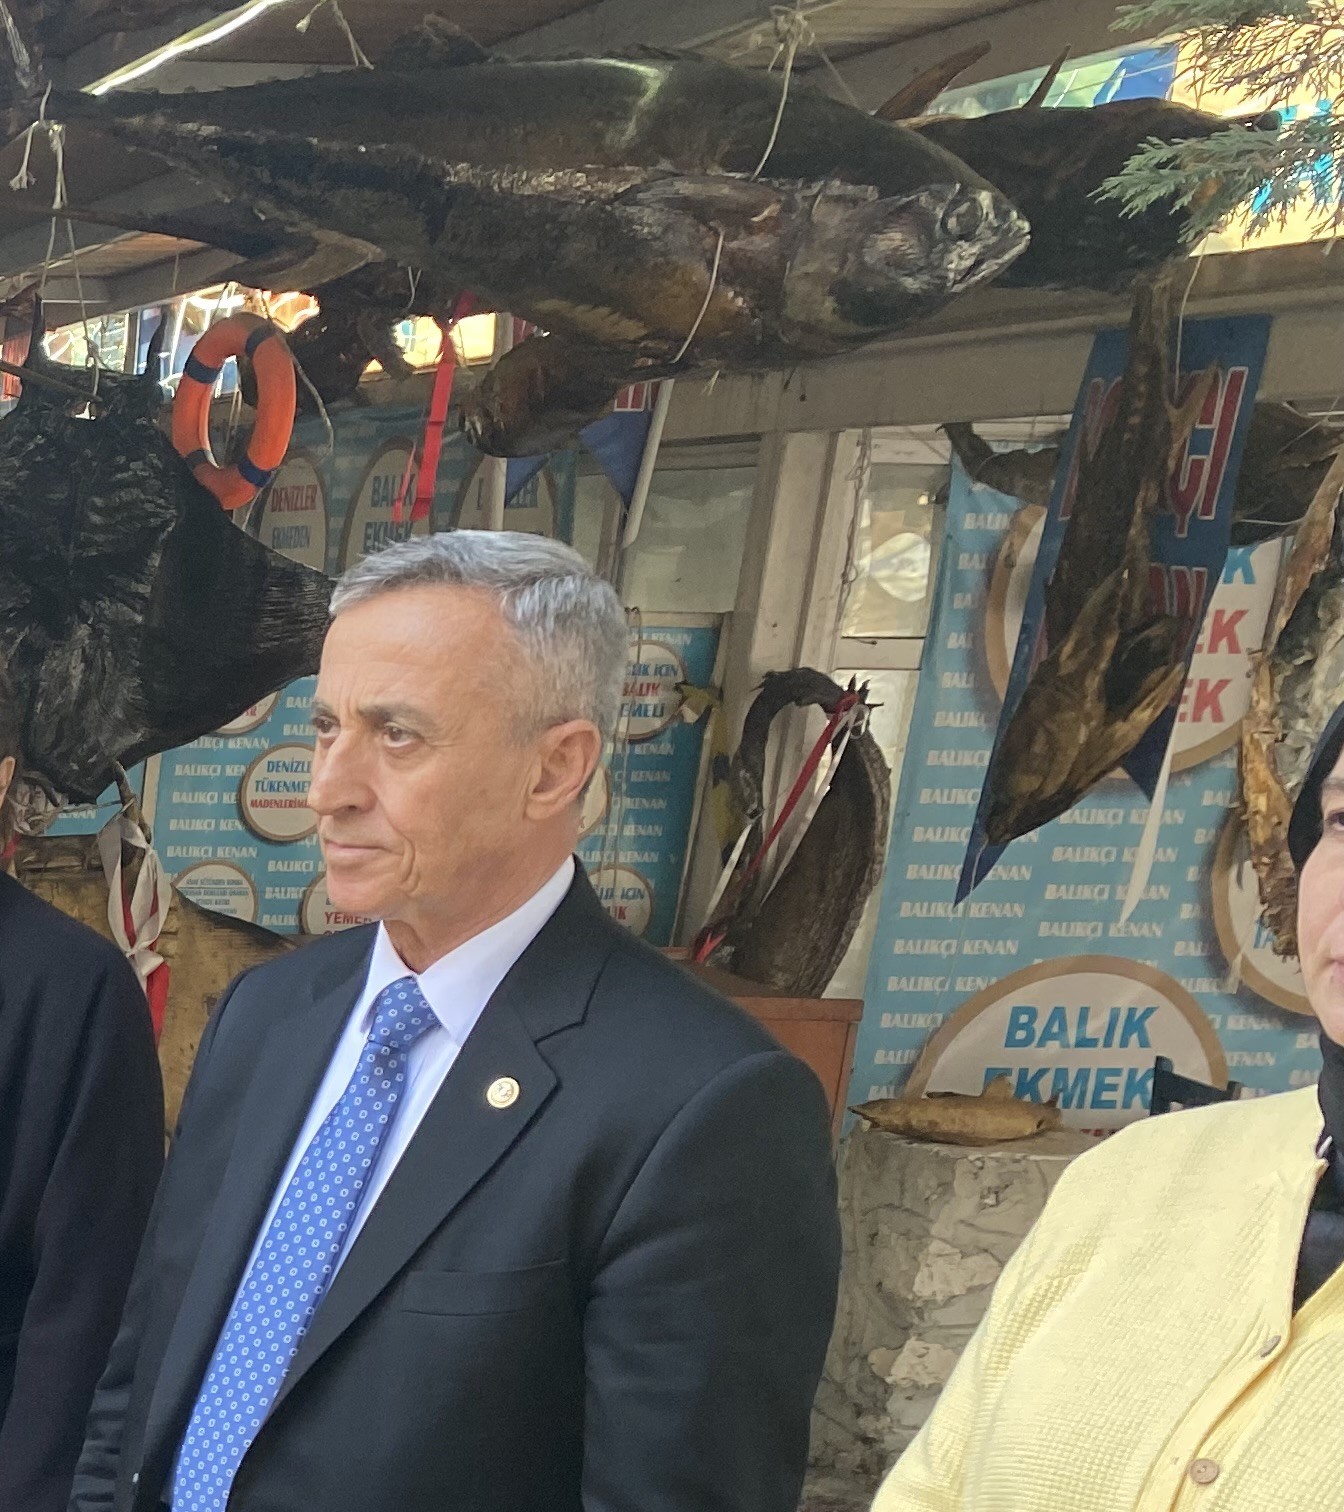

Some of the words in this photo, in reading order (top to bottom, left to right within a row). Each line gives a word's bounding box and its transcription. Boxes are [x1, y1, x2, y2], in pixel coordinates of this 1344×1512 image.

[370, 474, 415, 508] BALK
[267, 757, 312, 773] DENİZLE
[256, 777, 311, 793] TÜKENME
[968, 902, 1026, 918] KENAN
[893, 938, 958, 958] BALIKÇI
[962, 939, 1019, 956] KENAN
[1003, 1005, 1160, 1049] BALIK
